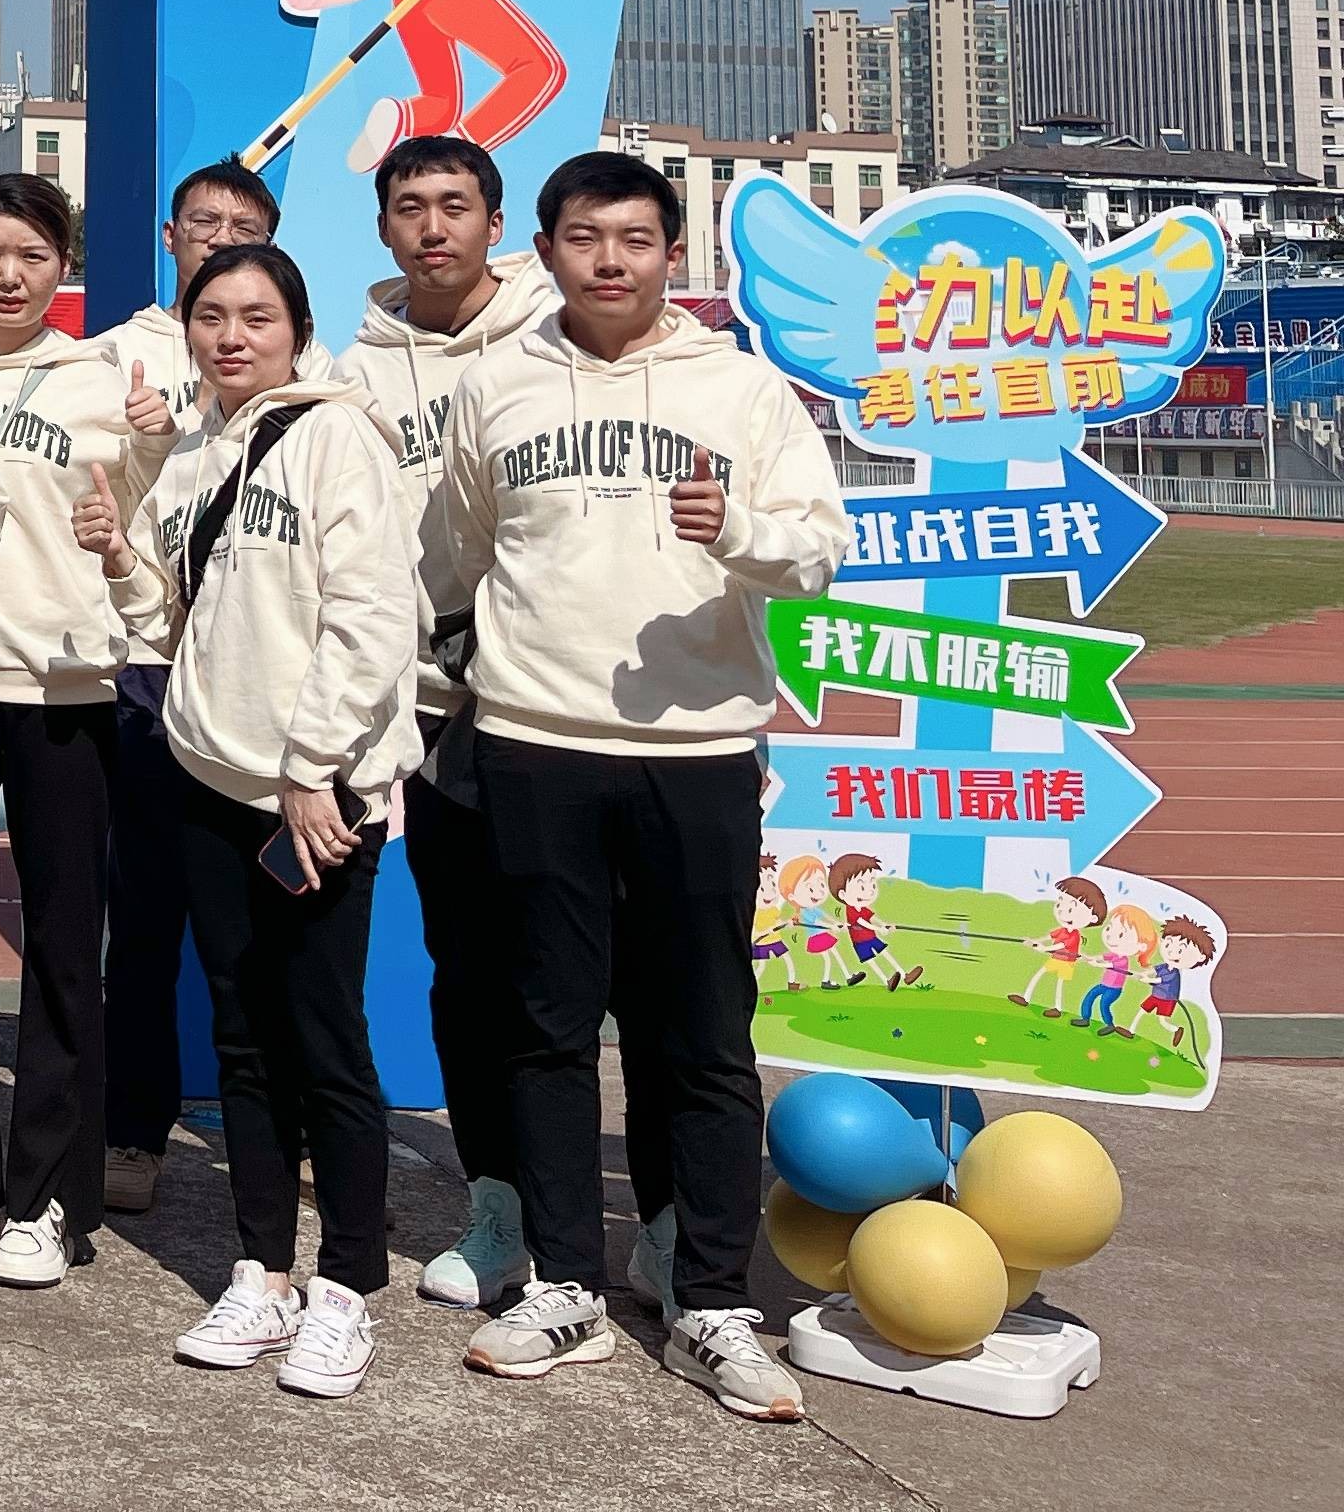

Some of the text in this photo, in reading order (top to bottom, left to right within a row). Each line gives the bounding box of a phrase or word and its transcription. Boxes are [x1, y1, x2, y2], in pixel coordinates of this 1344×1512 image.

[853, 355, 1125, 430] 勇往直前
[503, 419, 733, 497] DREAM OF YOUH
[844, 501, 1104, 568] 挑战自我
[799, 614, 1070, 703] 我不服输
[826, 764, 1086, 823] 我们最棒
